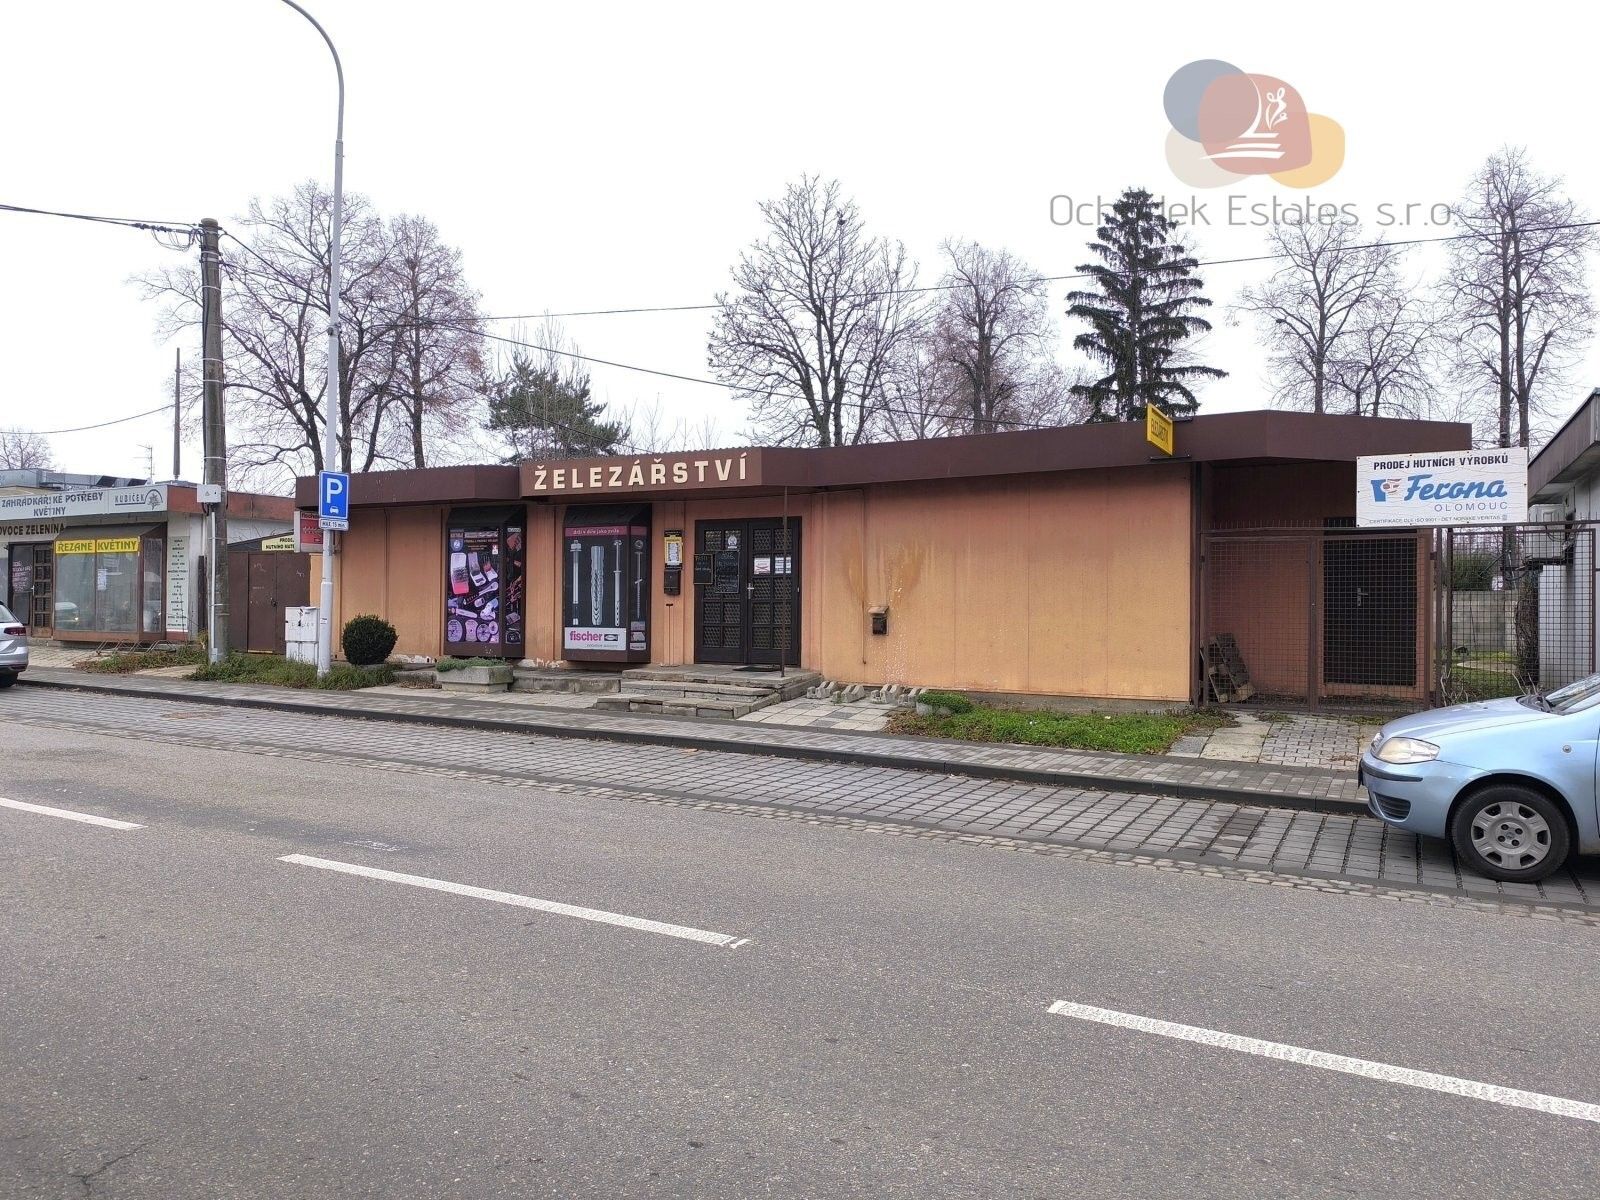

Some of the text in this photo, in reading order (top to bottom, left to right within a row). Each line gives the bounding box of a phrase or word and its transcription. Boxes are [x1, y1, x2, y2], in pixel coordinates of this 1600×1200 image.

[1373, 453, 1508, 470] PRODEJ HUTNÍCH VÝROBKŮ
[534, 452, 748, 490] ŽELEZÁŘSTVÍ
[326, 477, 343, 504] P
[1404, 474, 1507, 501] Ferona
[65, 491, 103, 503] POTŘEBY
[1434, 501, 1507, 512] OLOMOUC
[25, 523, 65, 535] ZELENINA
[57, 539, 136, 552] ŘEZANÉ KVĚTINY
[570, 630, 603, 641] fischer
